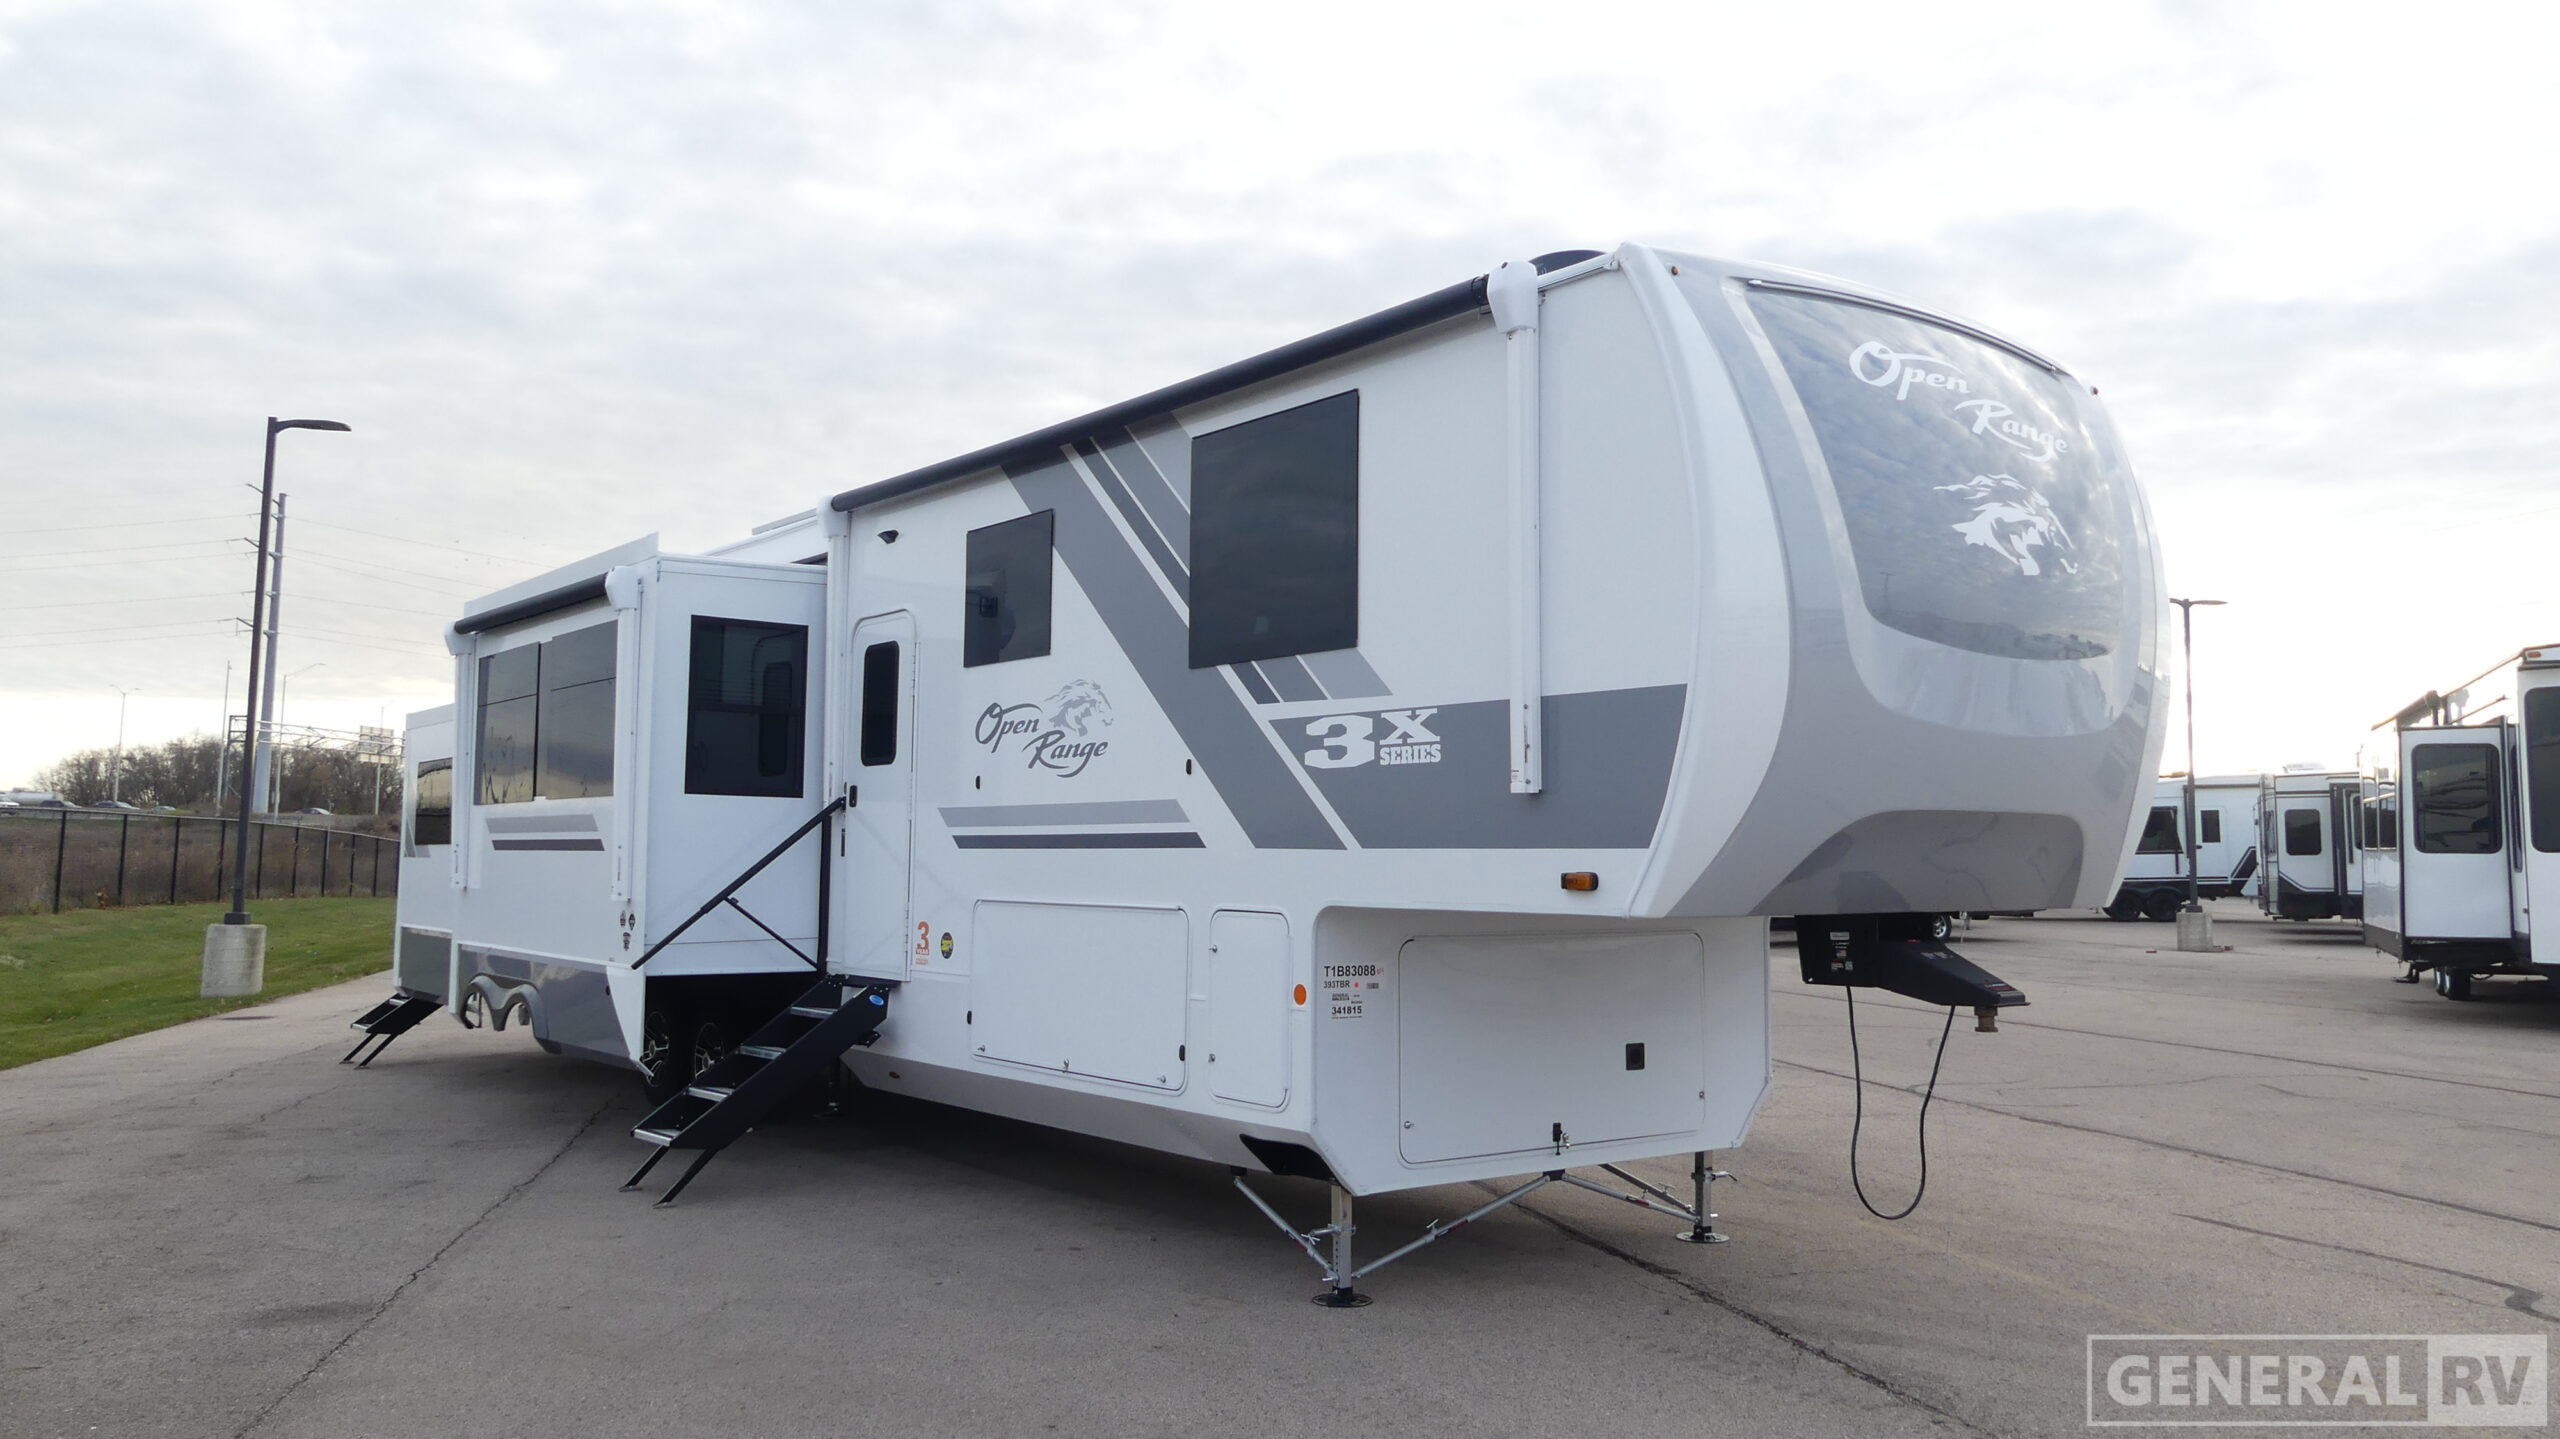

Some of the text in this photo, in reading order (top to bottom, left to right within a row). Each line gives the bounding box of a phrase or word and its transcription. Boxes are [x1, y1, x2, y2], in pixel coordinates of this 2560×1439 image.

[1849, 340, 1971, 401] Open
[1954, 398, 2069, 463] Range
[975, 701, 1043, 754] Open
[1022, 729, 1109, 778] Range
[1380, 743, 1441, 766] SERIES
[917, 921, 929, 949] 3
[1323, 980, 1350, 989] 393TBR
[1324, 965, 1376, 977] T1B83088
[1331, 1006, 1362, 1015] 341815
